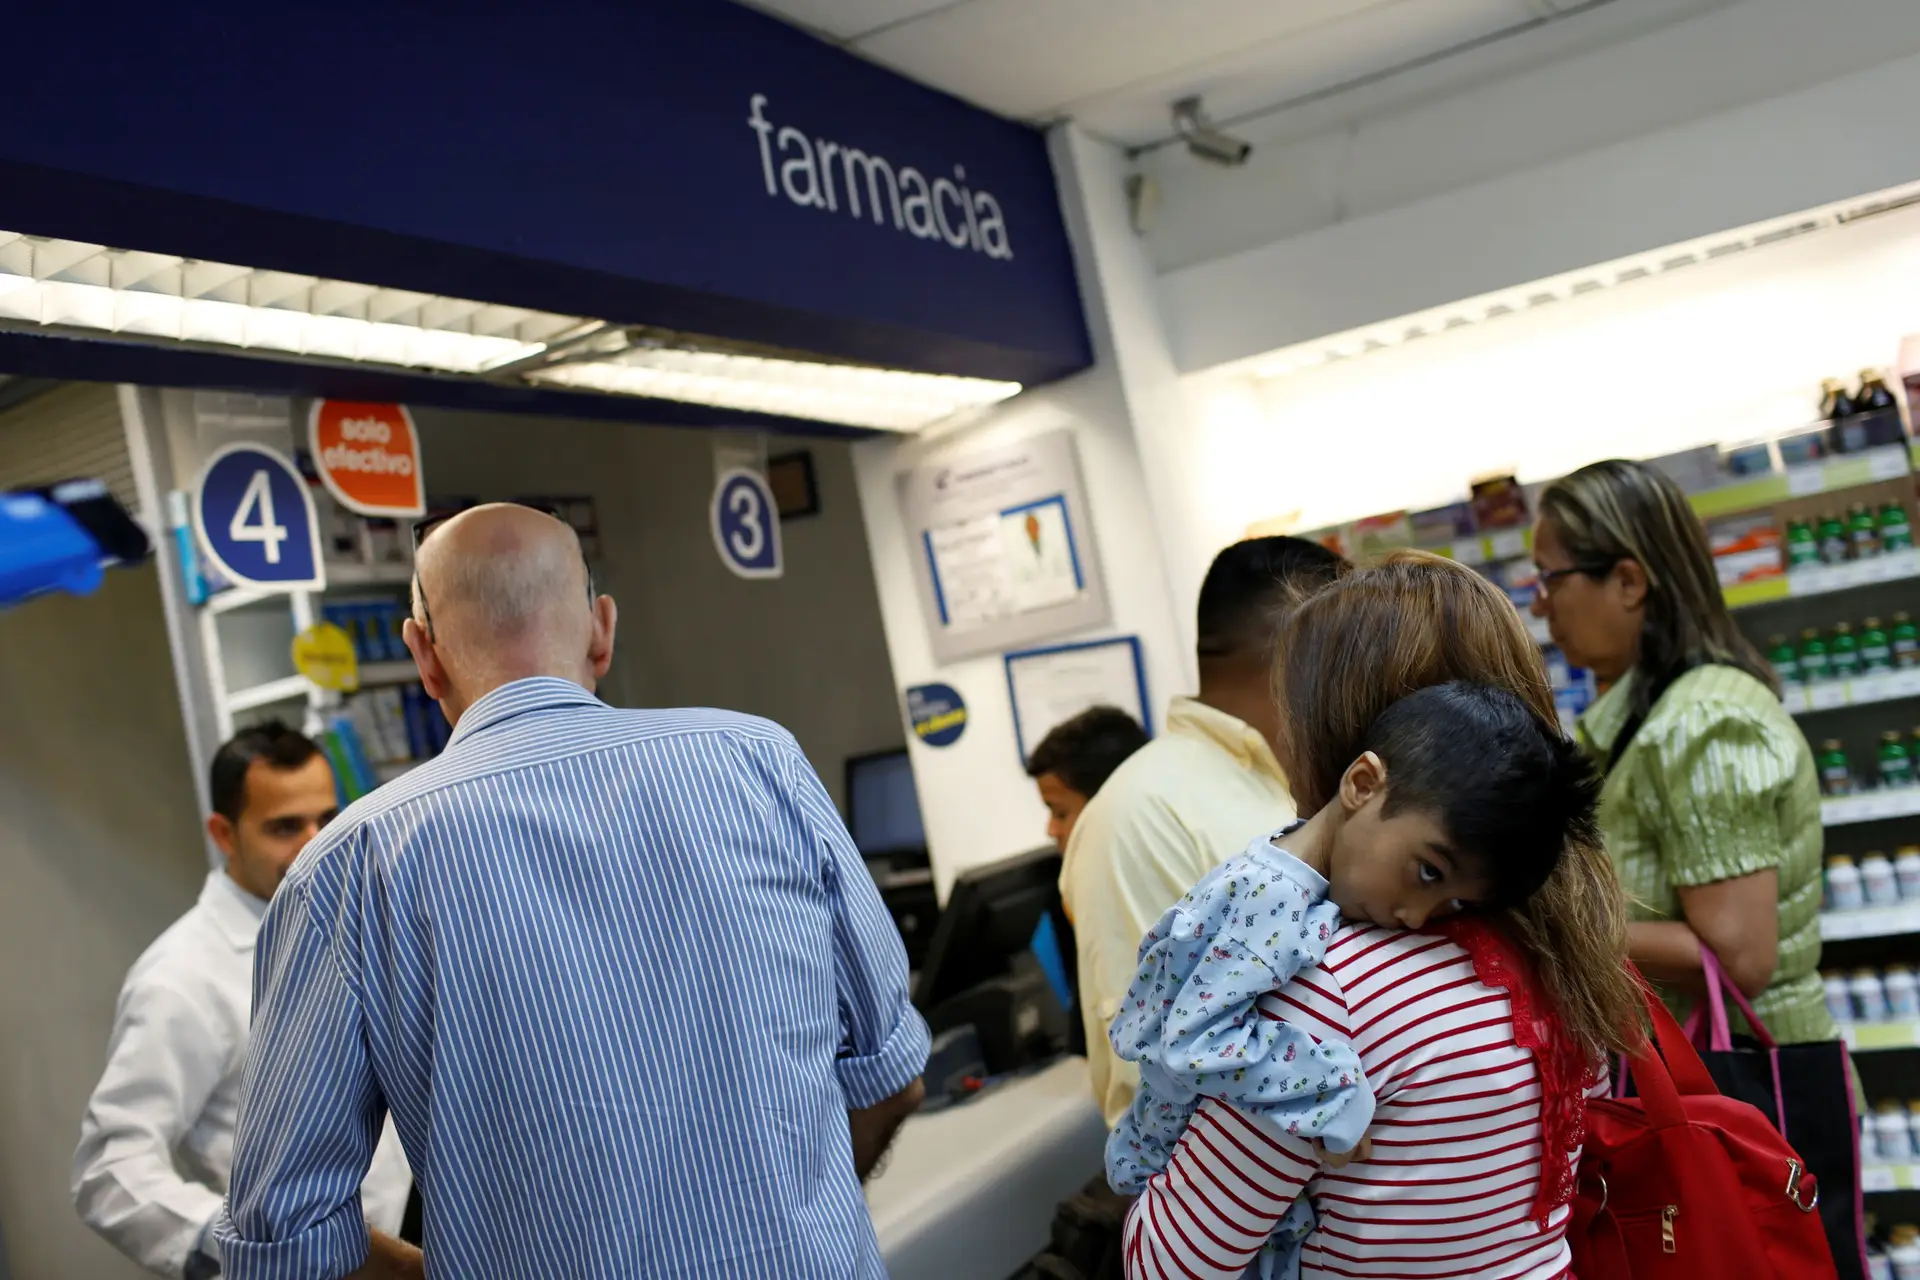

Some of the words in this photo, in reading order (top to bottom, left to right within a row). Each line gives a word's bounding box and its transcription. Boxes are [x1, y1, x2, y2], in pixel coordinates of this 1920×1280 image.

[747, 94, 1014, 261] farmacia
[324, 443, 412, 477] efectivo
[341, 416, 391, 444] solo
[229, 470, 288, 564] 4
[729, 486, 764, 560] 3
